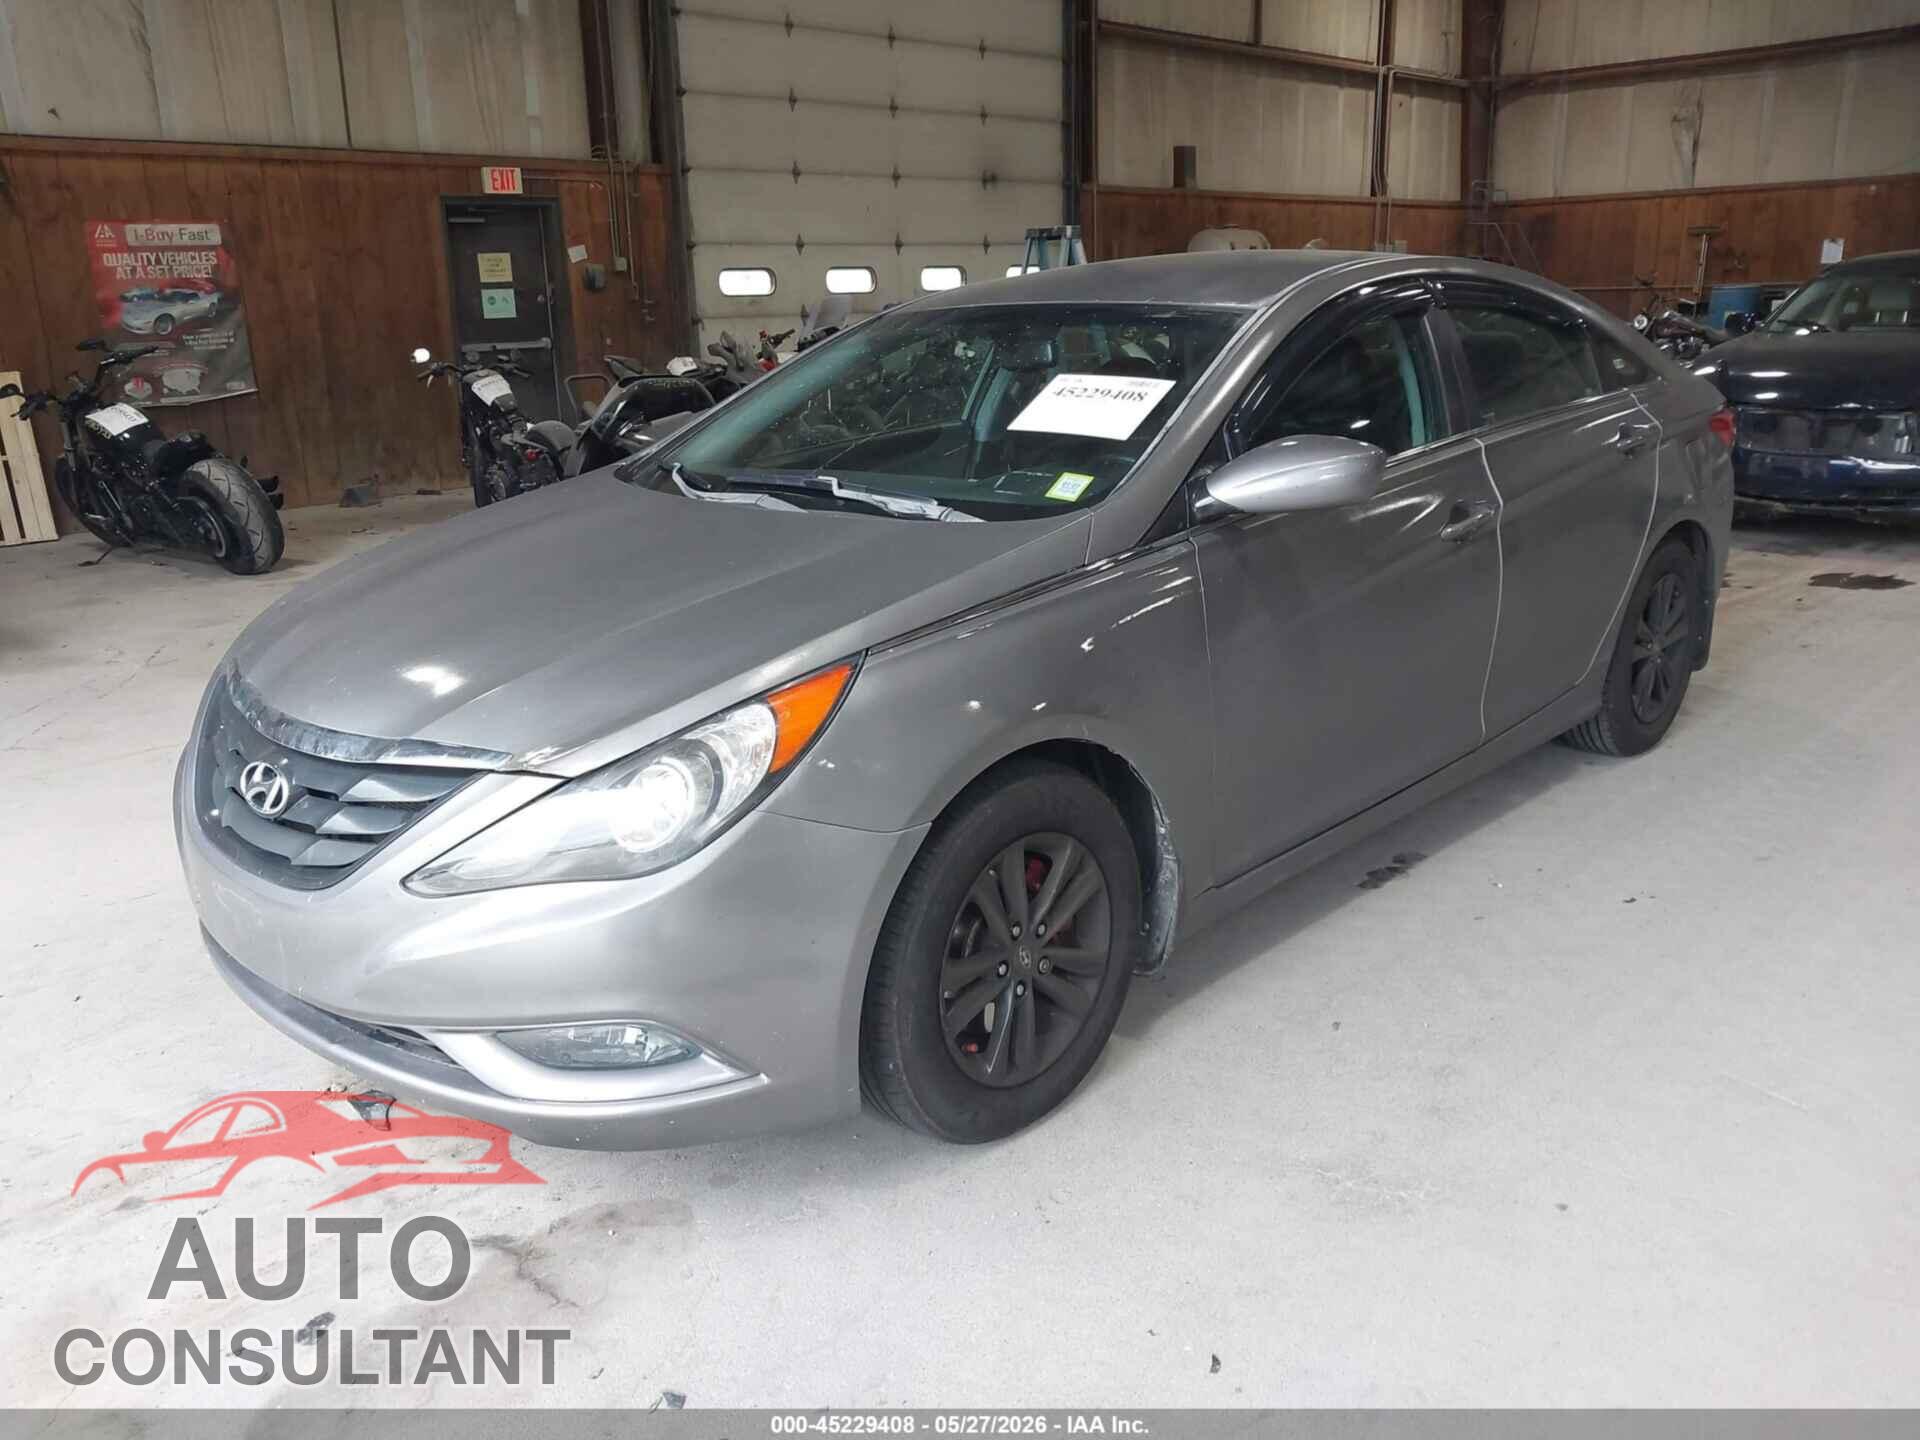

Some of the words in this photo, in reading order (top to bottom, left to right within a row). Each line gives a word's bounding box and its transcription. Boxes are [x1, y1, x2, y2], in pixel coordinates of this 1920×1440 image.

[490, 168, 516, 191] EXIT
[134, 228, 174, 245] I-Buy
[178, 227, 211, 241] Fast
[103, 252, 157, 266] QUALITY
[158, 251, 217, 265] VEHICLES
[115, 266, 132, 280] AT
[135, 266, 146, 279] A
[147, 265, 170, 279] SET
[173, 264, 212, 278] PRICE!
[1052, 386, 1149, 402] 45229408
